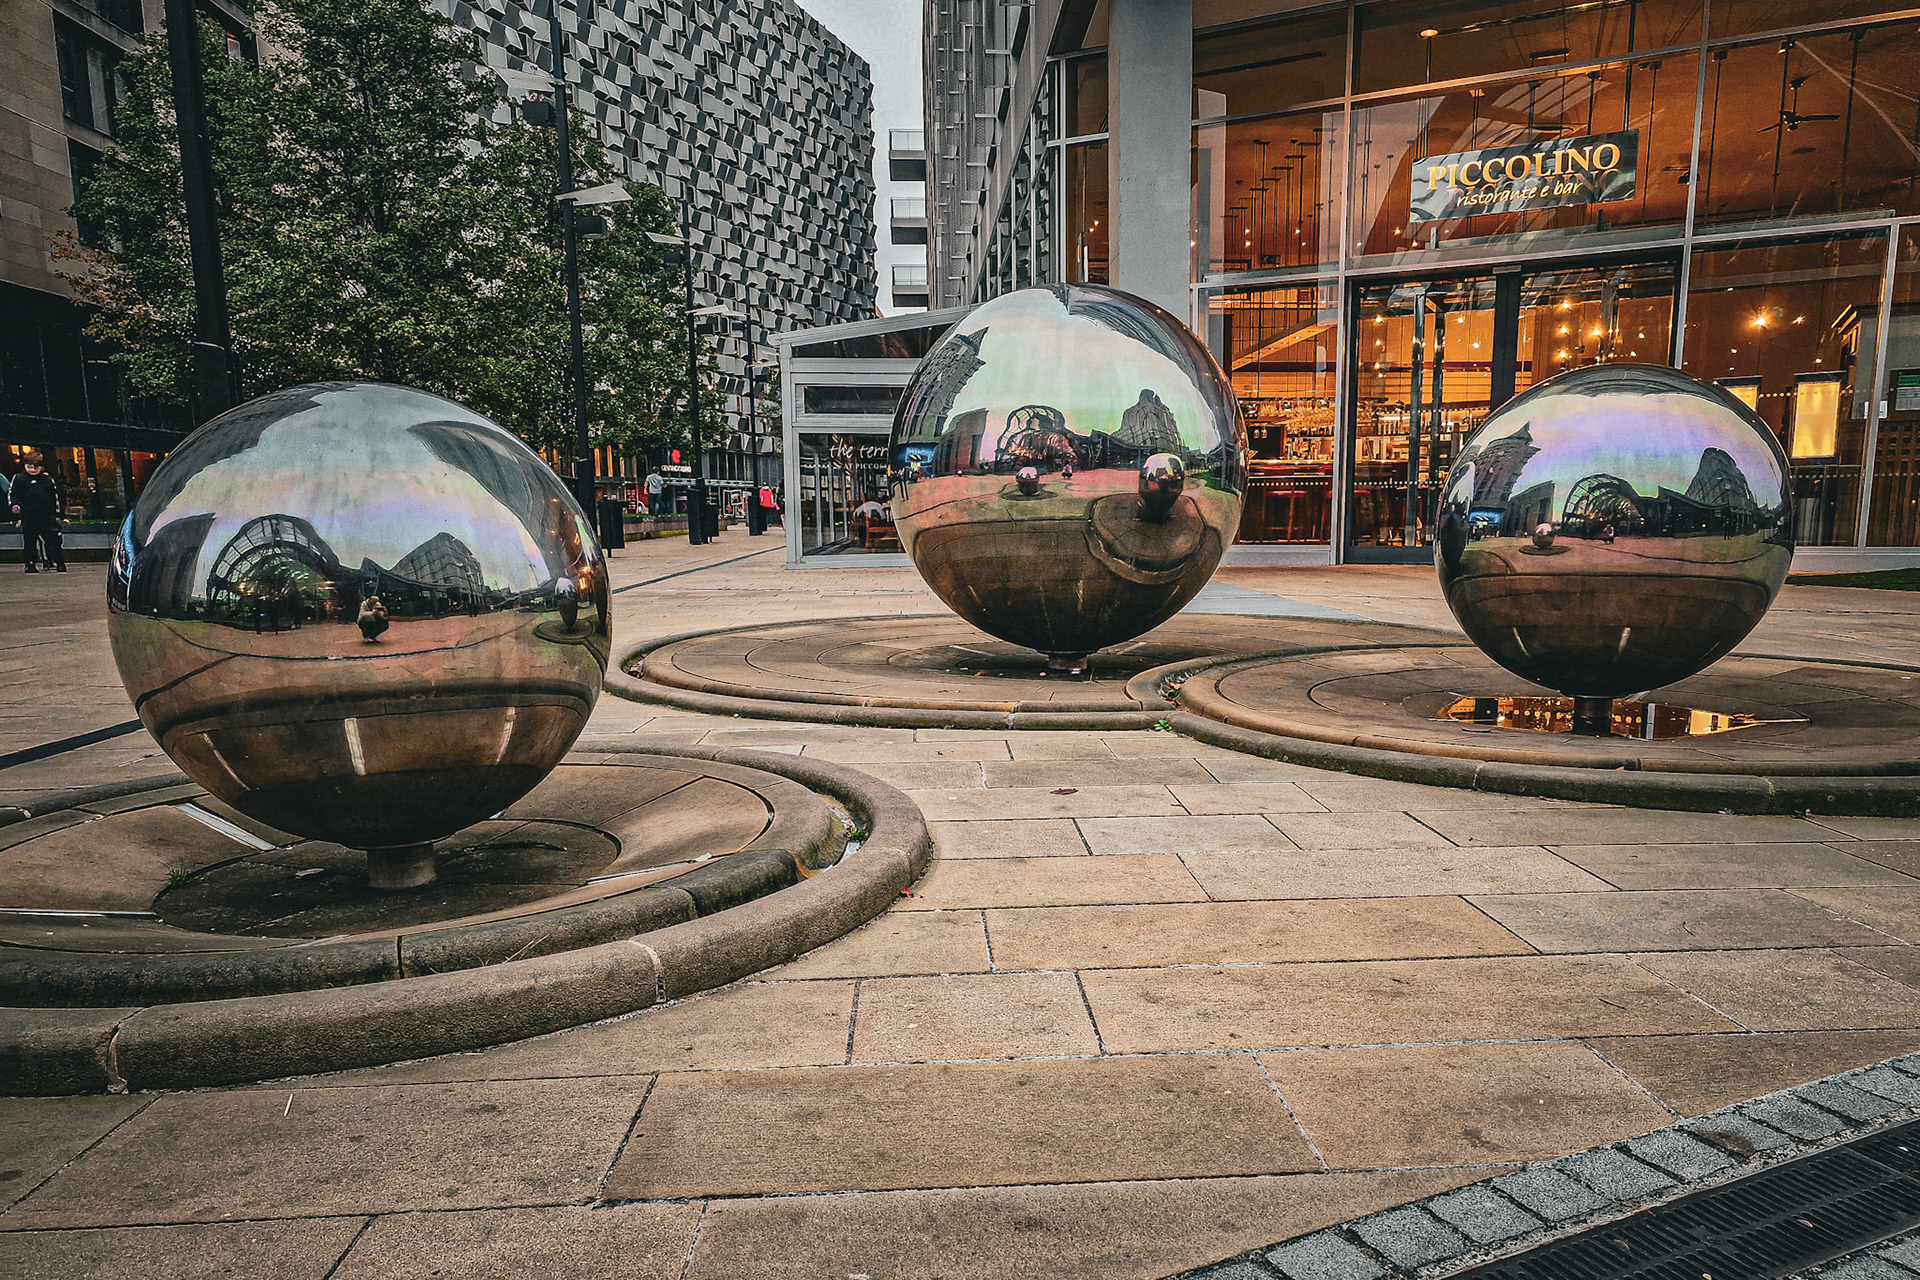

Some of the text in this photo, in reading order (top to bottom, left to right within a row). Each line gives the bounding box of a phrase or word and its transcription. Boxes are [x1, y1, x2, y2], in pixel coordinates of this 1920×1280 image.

[1426, 143, 1621, 191] PICCOLINO
[1456, 180, 1584, 208] ristorante e bar
[829, 437, 854, 459] the
[859, 445, 889, 459] terr
